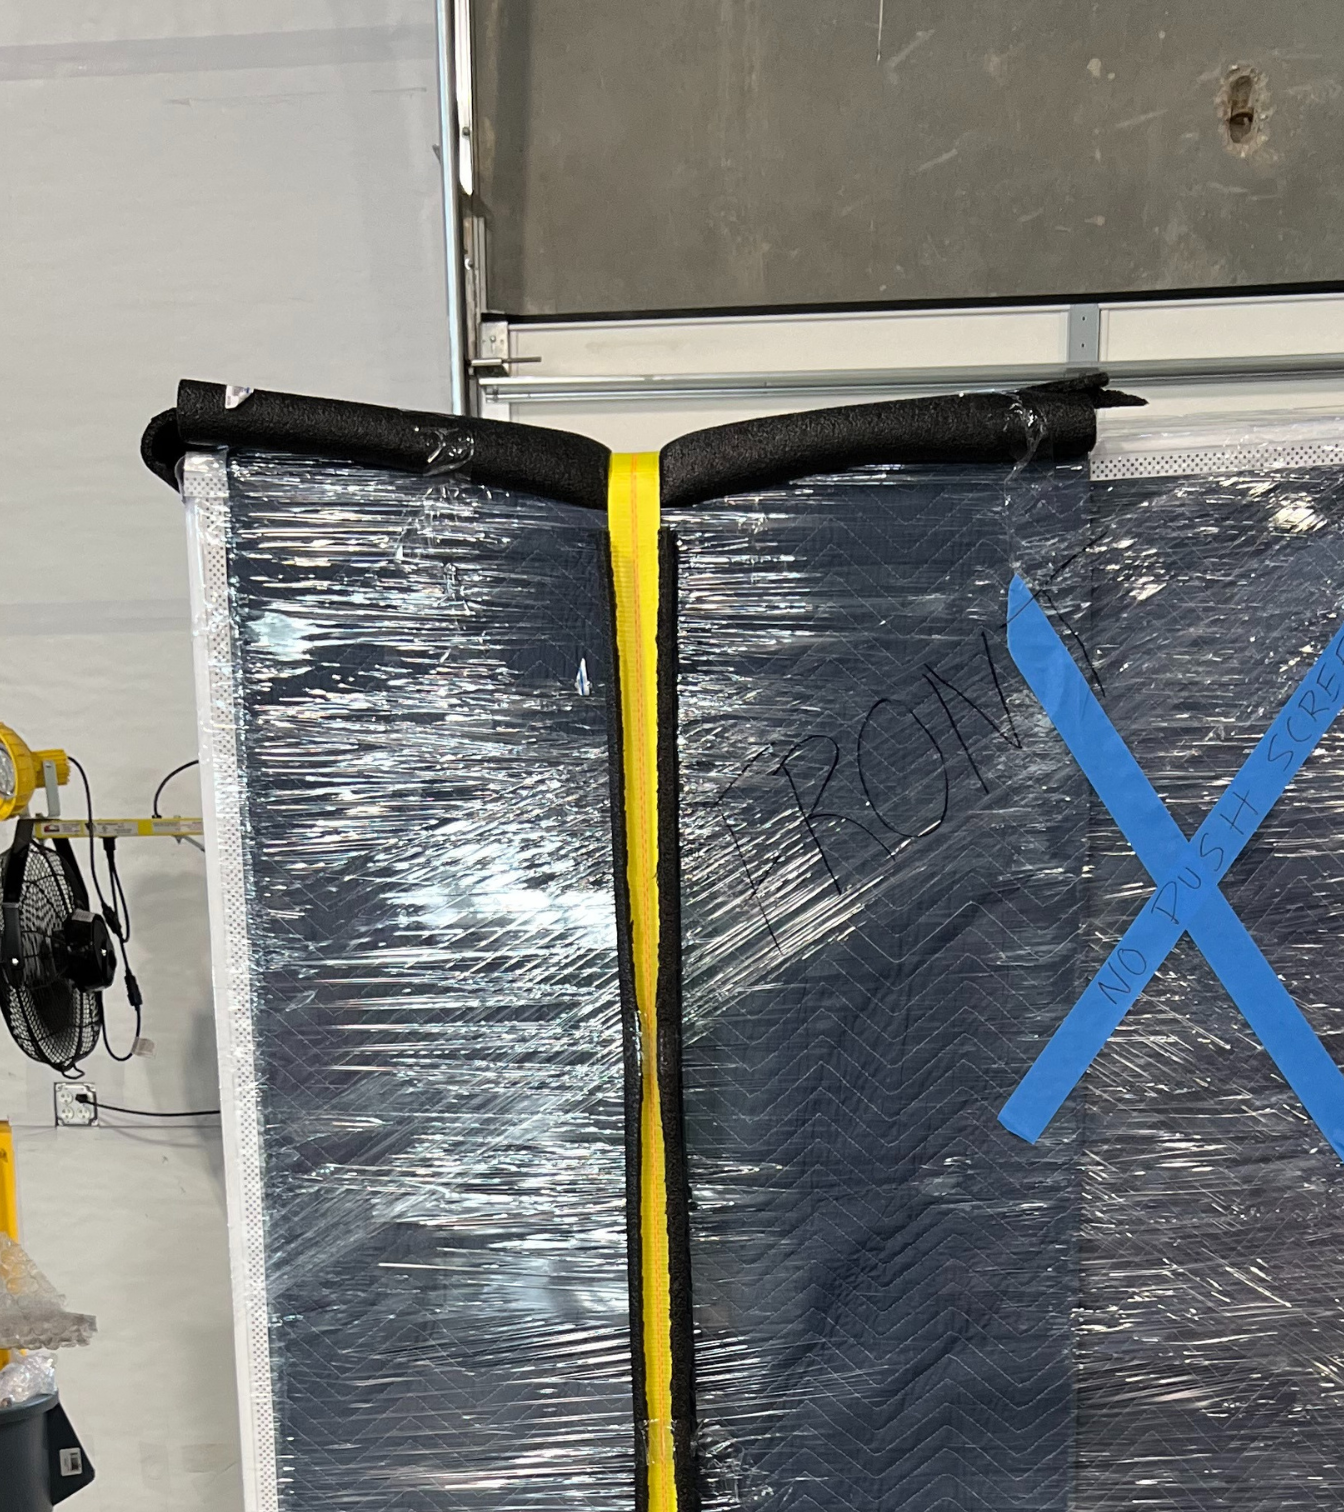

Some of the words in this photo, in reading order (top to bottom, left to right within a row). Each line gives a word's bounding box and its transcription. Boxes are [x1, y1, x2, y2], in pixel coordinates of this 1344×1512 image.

[714, 530, 1109, 957] FRONT
[1096, 946, 1148, 1006] NO
[1150, 788, 1260, 926] PUSH
